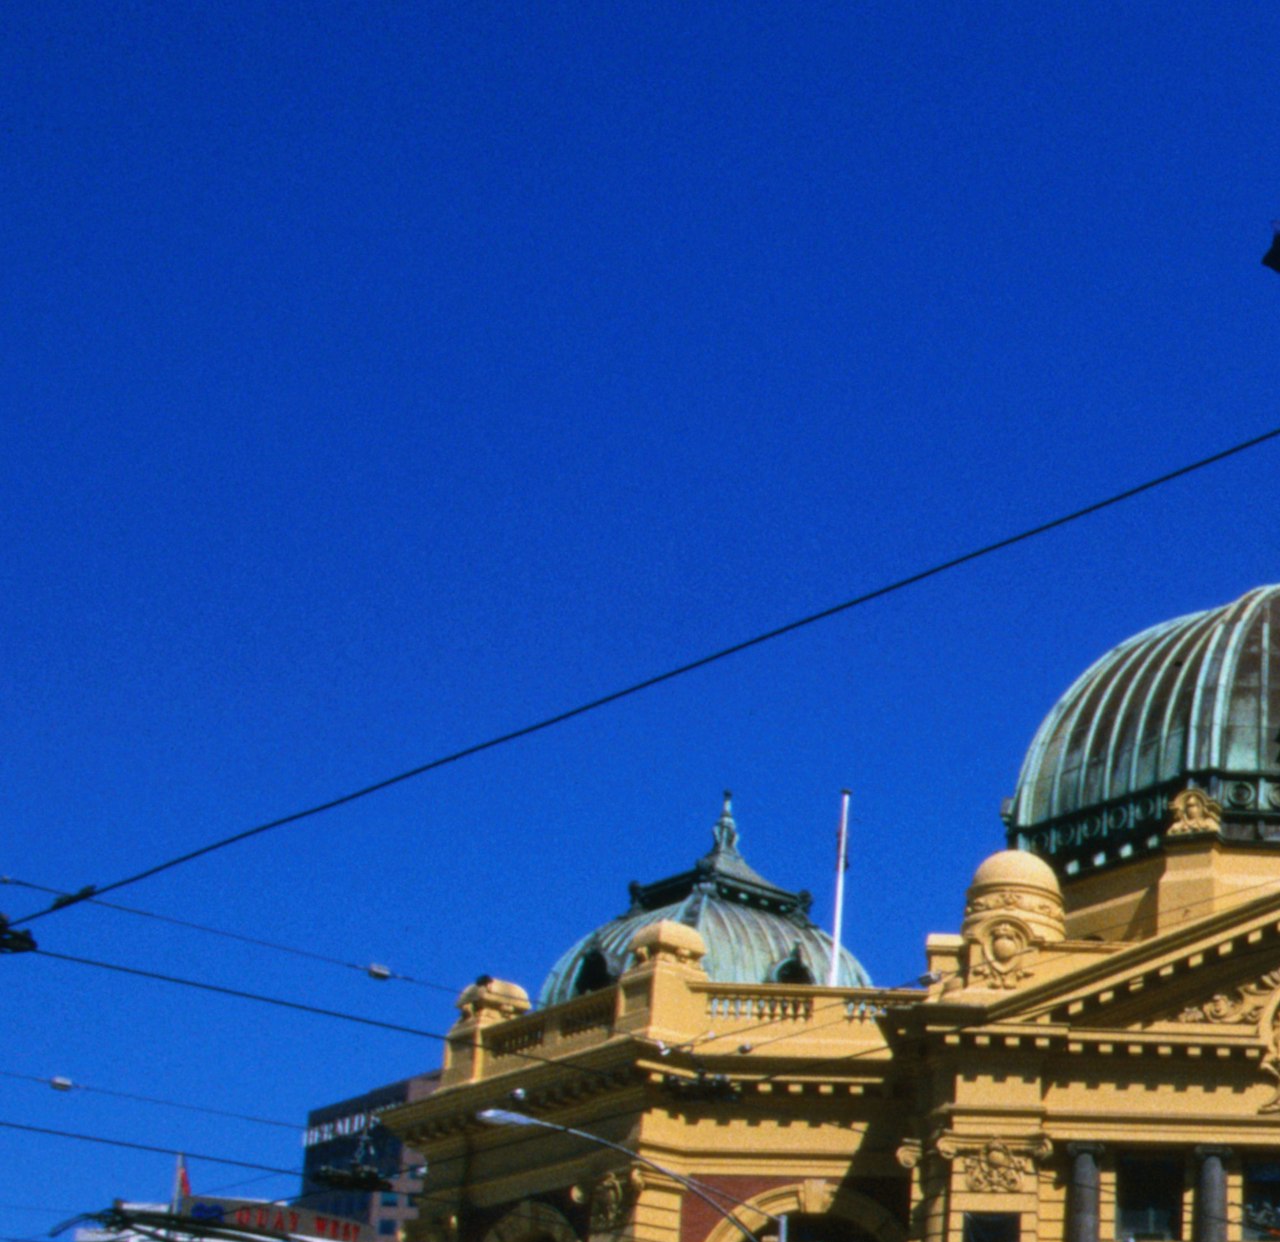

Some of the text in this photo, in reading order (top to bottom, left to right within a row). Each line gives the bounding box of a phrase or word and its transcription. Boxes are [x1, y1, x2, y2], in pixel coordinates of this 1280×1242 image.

[302, 1111, 367, 1147] HERALD
[236, 1206, 361, 1242] QUAY WEST
